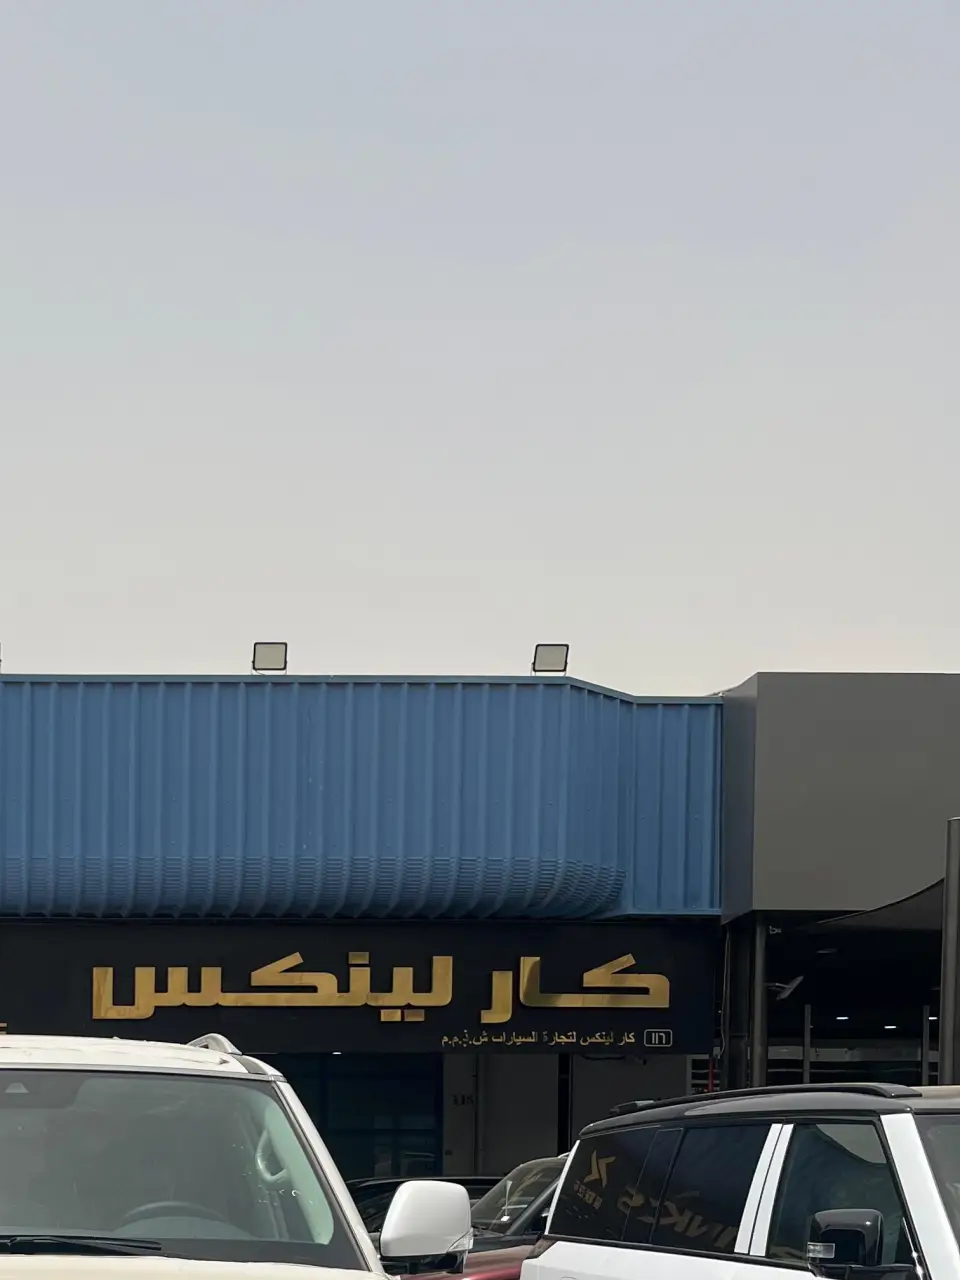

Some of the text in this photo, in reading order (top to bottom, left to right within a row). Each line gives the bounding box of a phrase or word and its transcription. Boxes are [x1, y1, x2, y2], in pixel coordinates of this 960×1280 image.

[92, 951, 670, 1023] كار لينكس
[617, 1031, 636, 1046] كار
